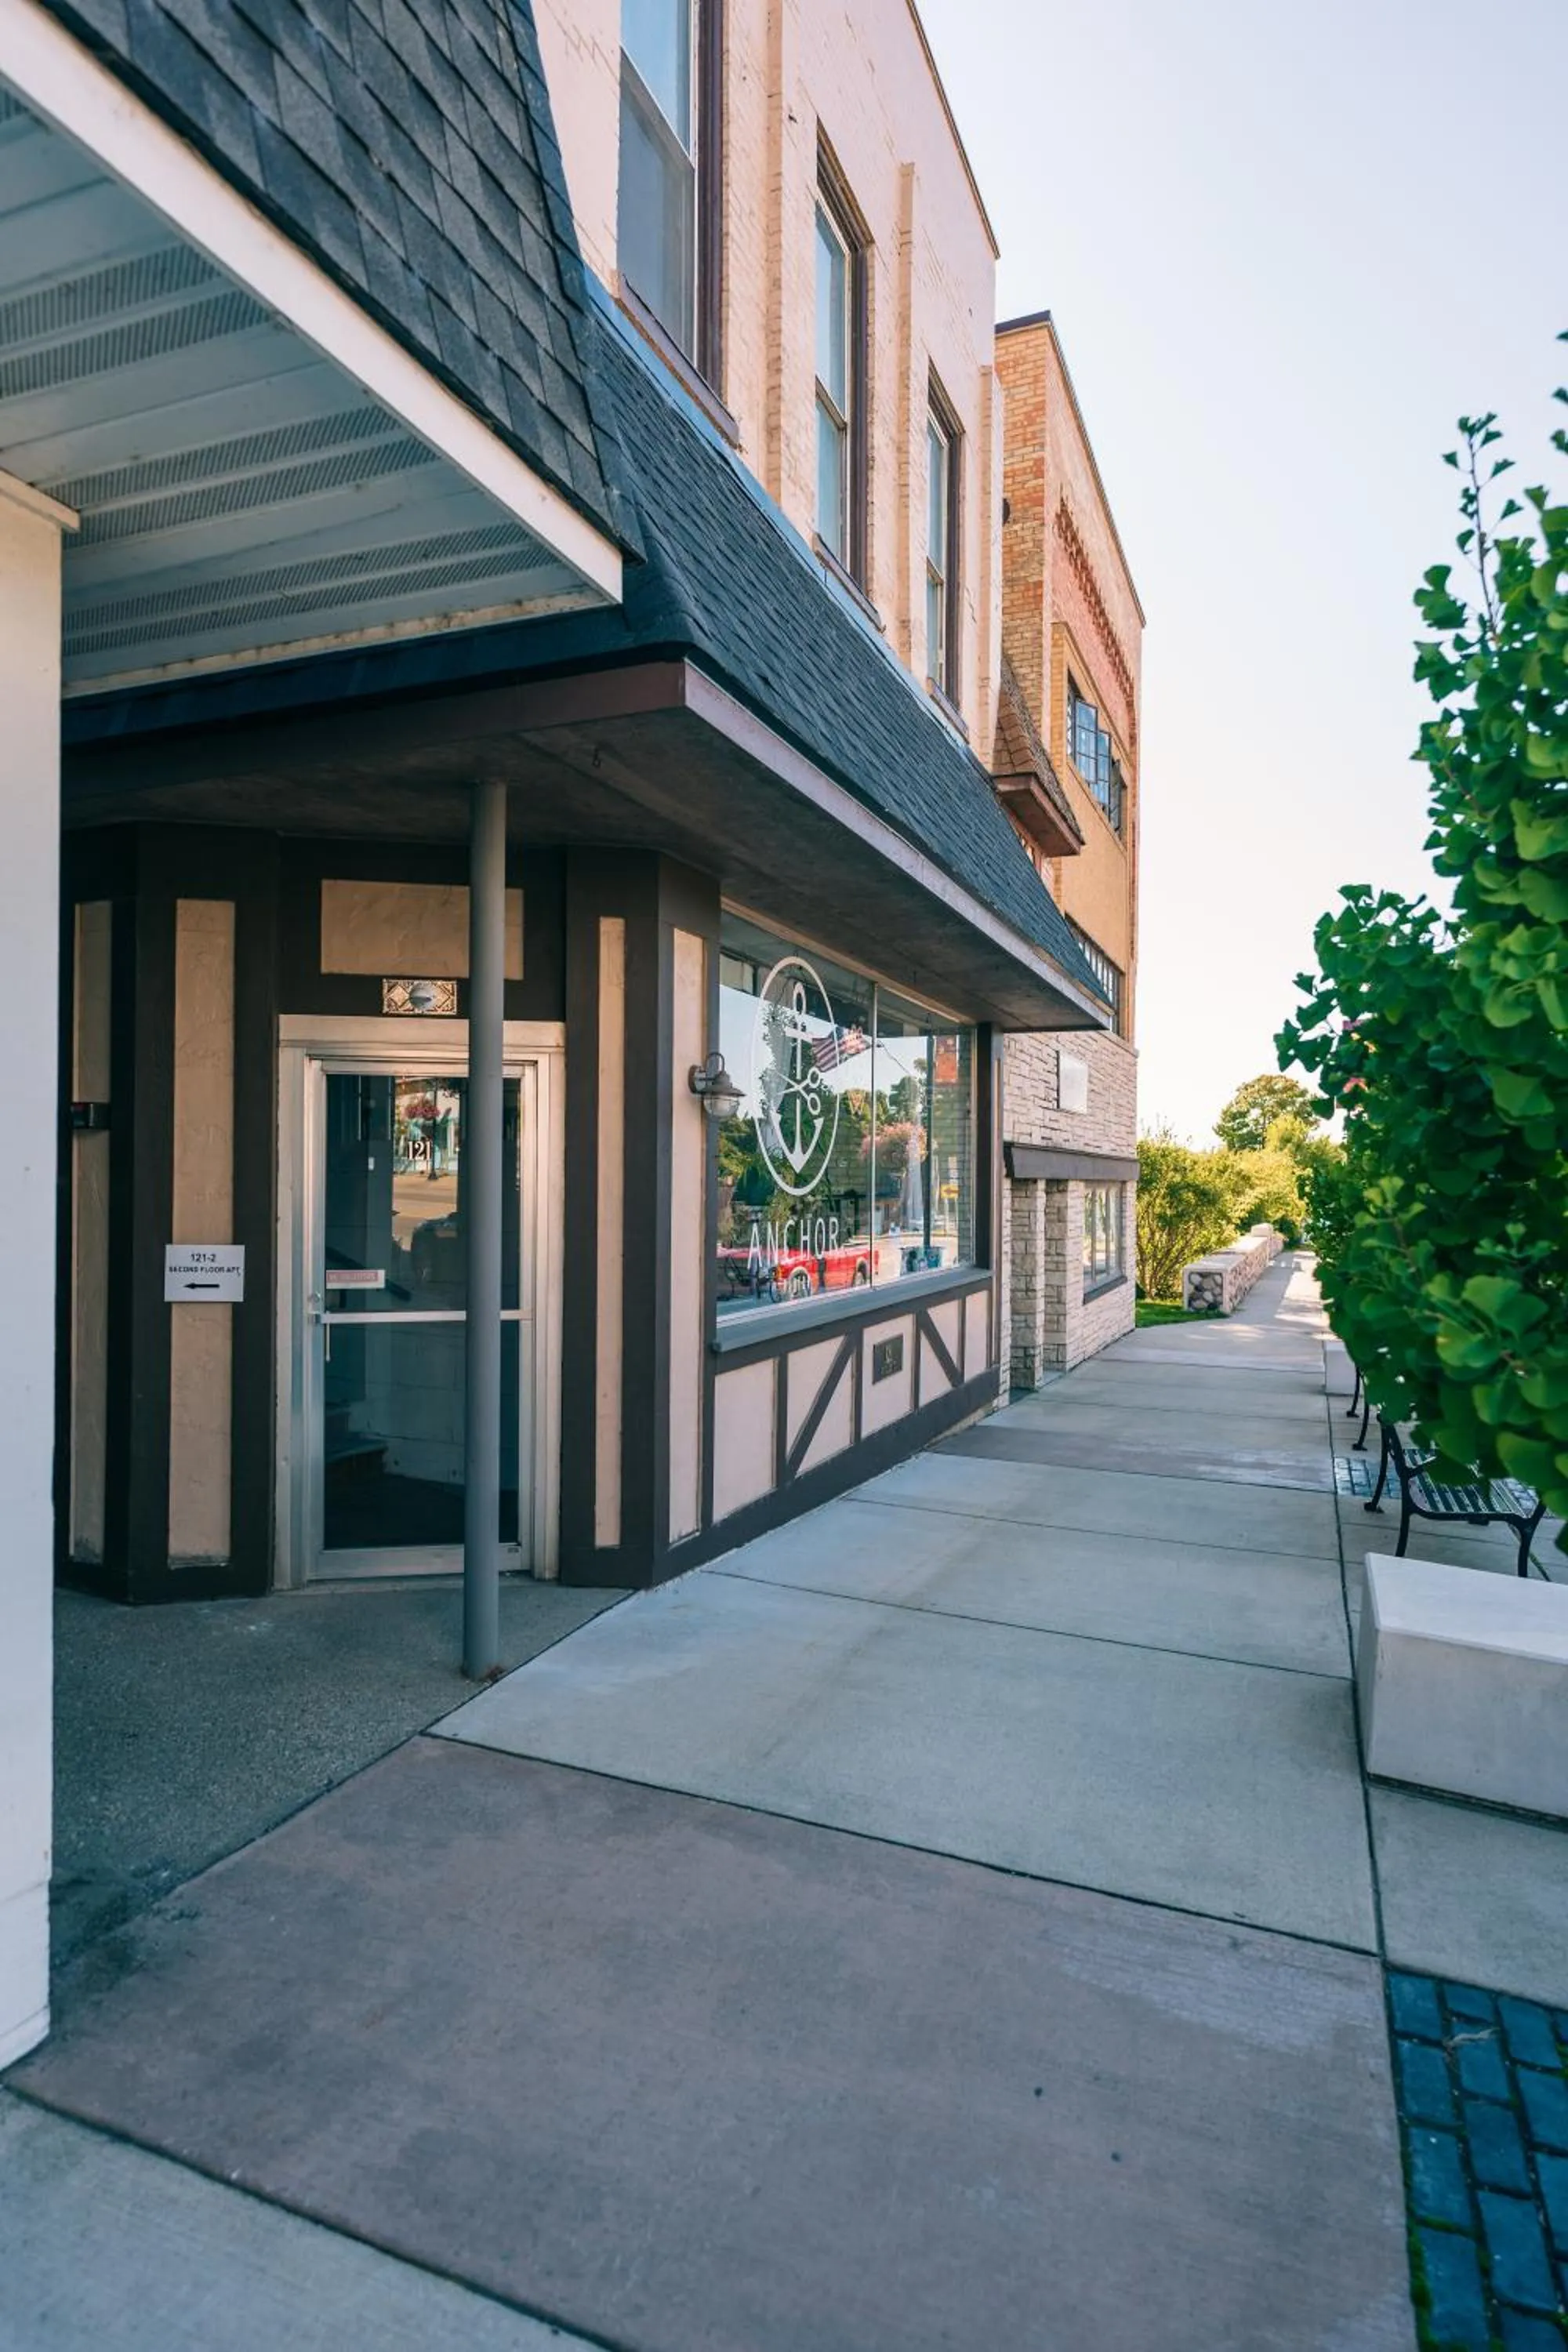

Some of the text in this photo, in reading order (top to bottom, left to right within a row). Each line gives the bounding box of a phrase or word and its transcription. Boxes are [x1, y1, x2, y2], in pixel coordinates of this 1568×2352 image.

[408, 1141, 430, 1161] 121
[747, 1217, 840, 1269] ANCHOR
[191, 1254, 216, 1262] 121-2
